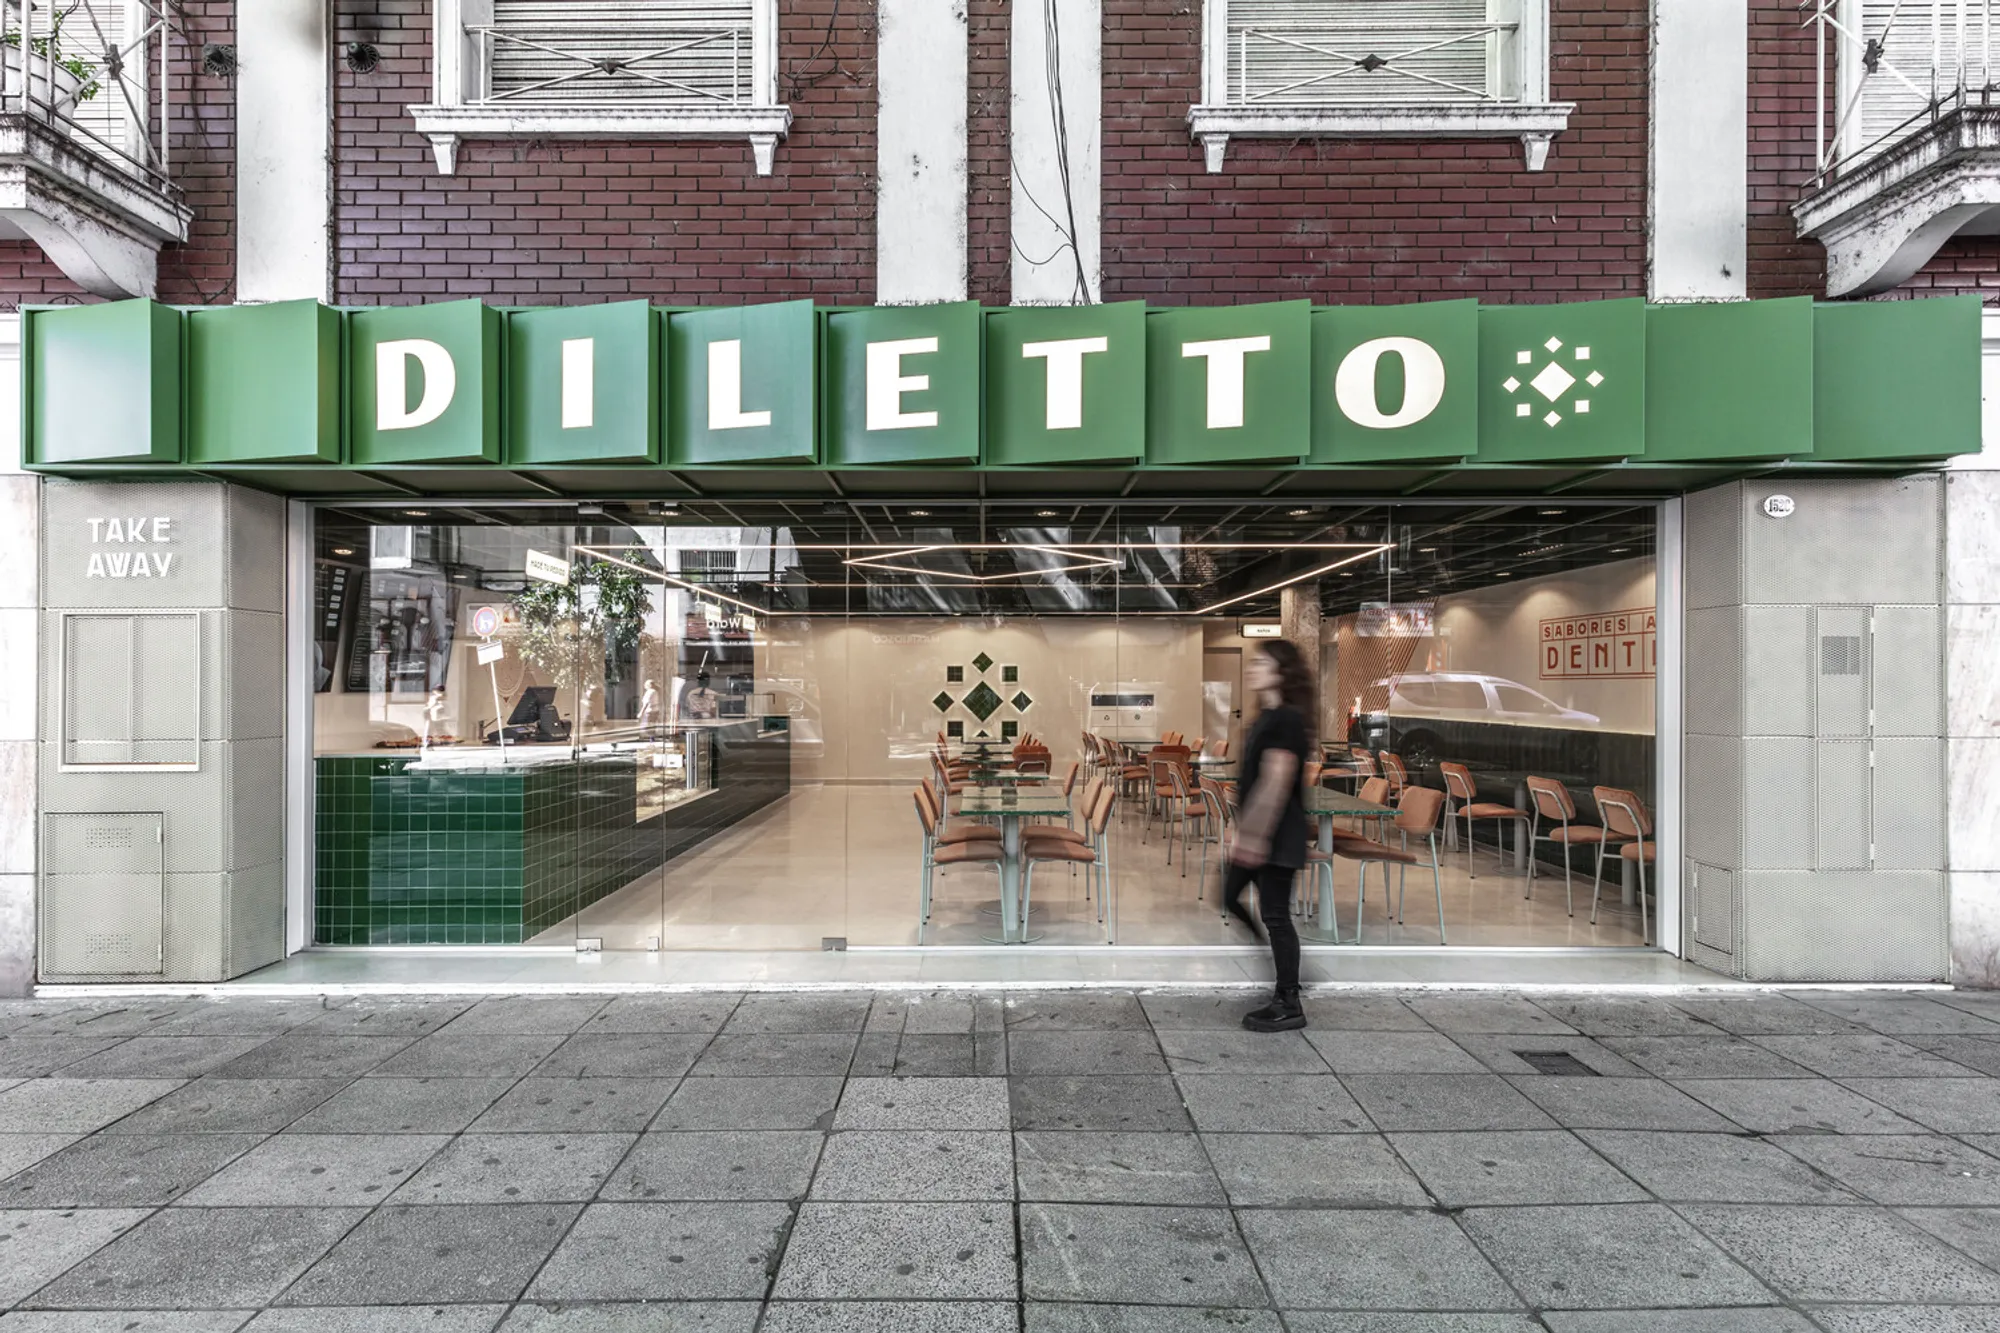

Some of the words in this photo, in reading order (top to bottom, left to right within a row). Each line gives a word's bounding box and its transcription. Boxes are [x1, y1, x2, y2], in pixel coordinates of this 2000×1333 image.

[376, 335, 1445, 431] DILETTO
[87, 517, 170, 543] TAKE
[87, 552, 173, 577] AWAY
[1544, 618, 1626, 638] SABORES
[1548, 640, 1656, 669] DENT
